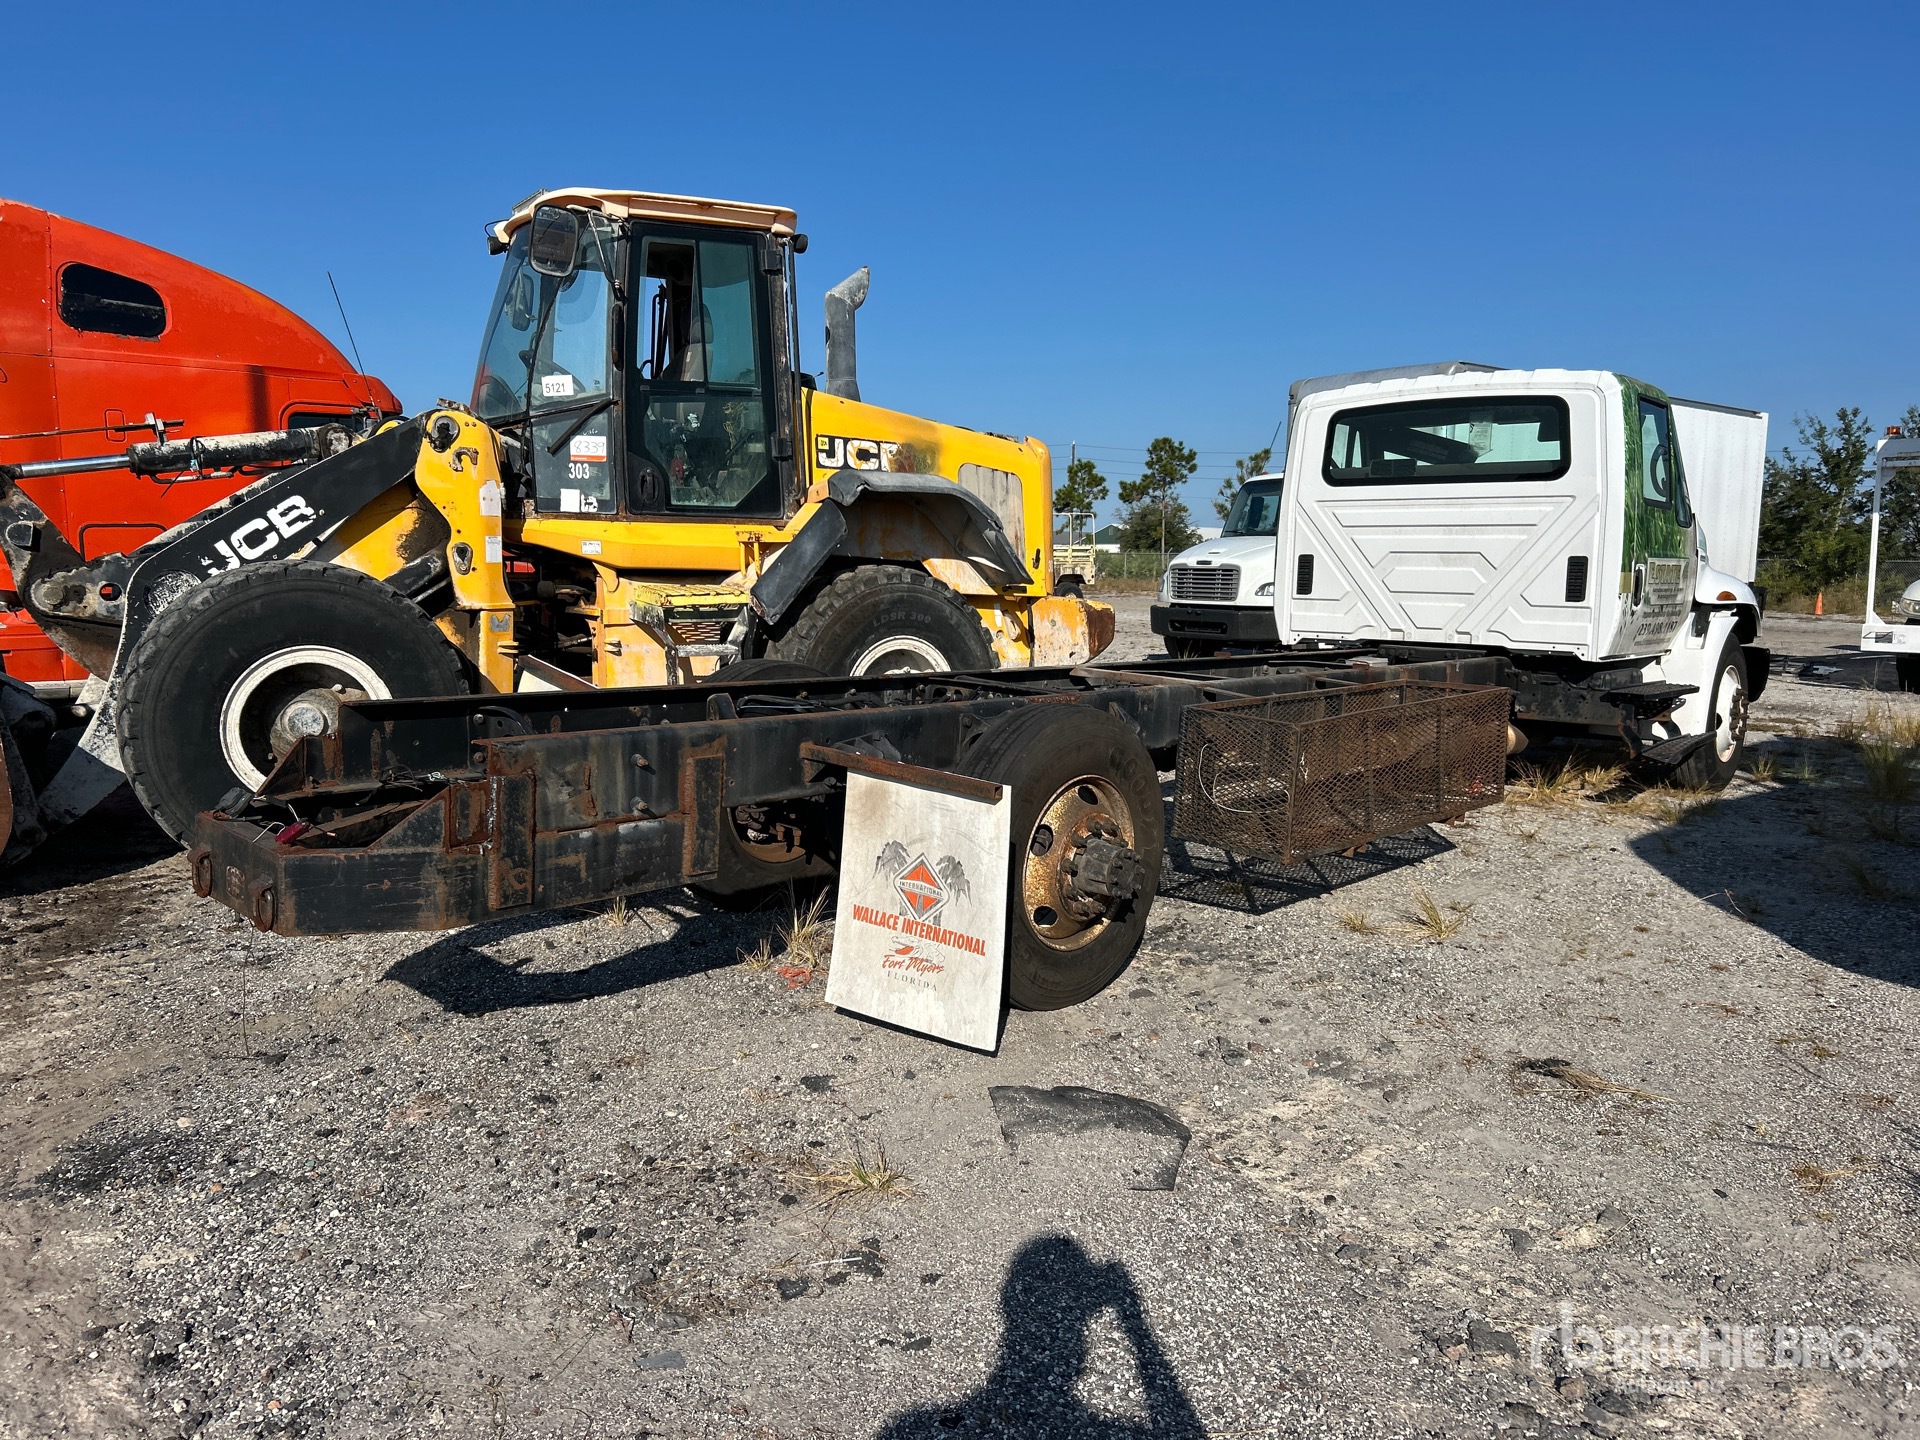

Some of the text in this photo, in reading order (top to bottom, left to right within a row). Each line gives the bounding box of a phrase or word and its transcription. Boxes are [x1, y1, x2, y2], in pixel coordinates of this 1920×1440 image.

[545, 382, 566, 394] 5121
[573, 440, 605, 454] 8339
[568, 462, 590, 479] 303
[198, 495, 317, 578] JCB
[899, 880, 943, 898] INTERNATIONAL
[853, 904, 986, 957] WALLACE INTERNATIONAL
[882, 954, 945, 977] Fort Myers
[887, 971, 938, 991] FLORIDA
